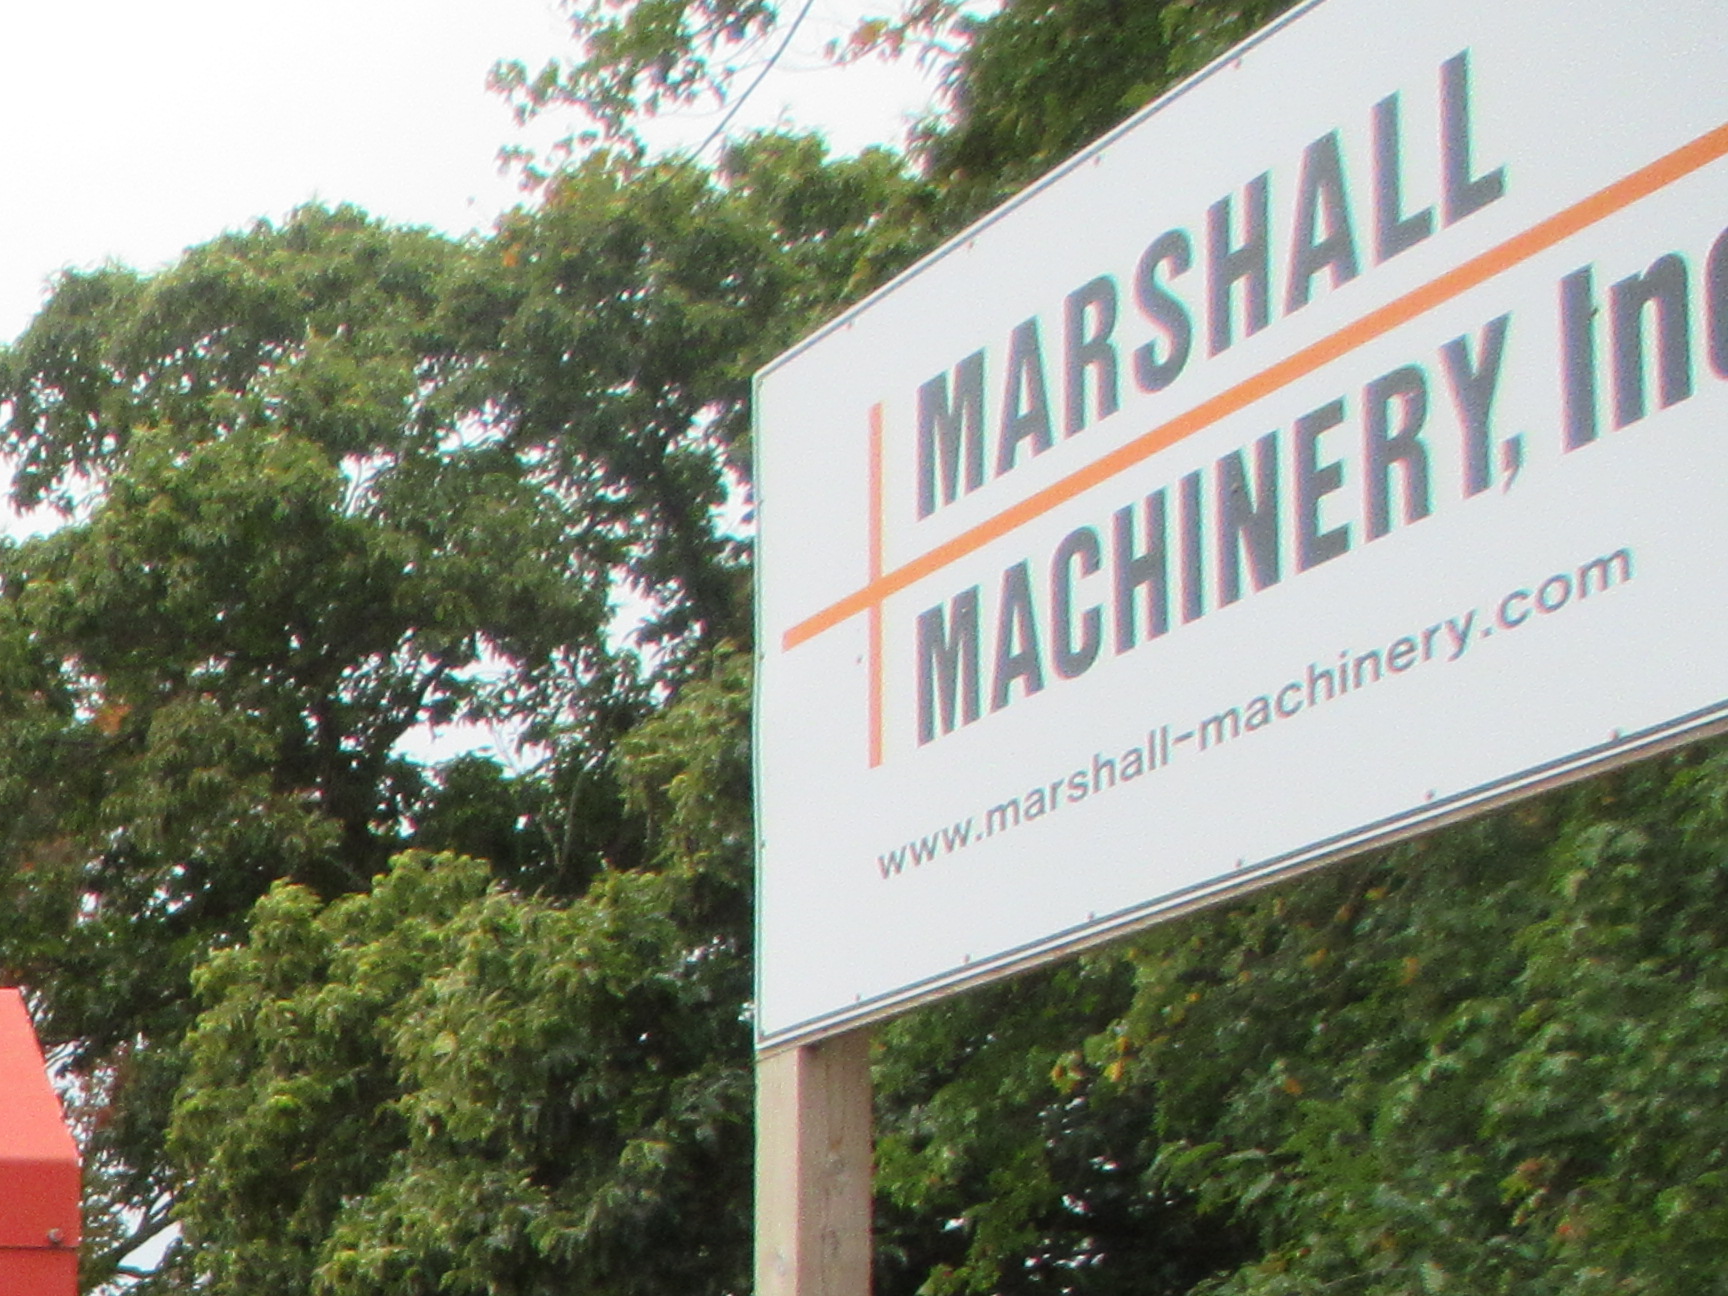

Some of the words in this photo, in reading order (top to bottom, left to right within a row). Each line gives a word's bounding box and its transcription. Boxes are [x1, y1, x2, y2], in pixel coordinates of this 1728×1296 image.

[917, 48, 1507, 521] MARSHALL
[877, 544, 1636, 880] www.marshall-machinery.com
[917, 311, 1523, 747] MACHINERY,
